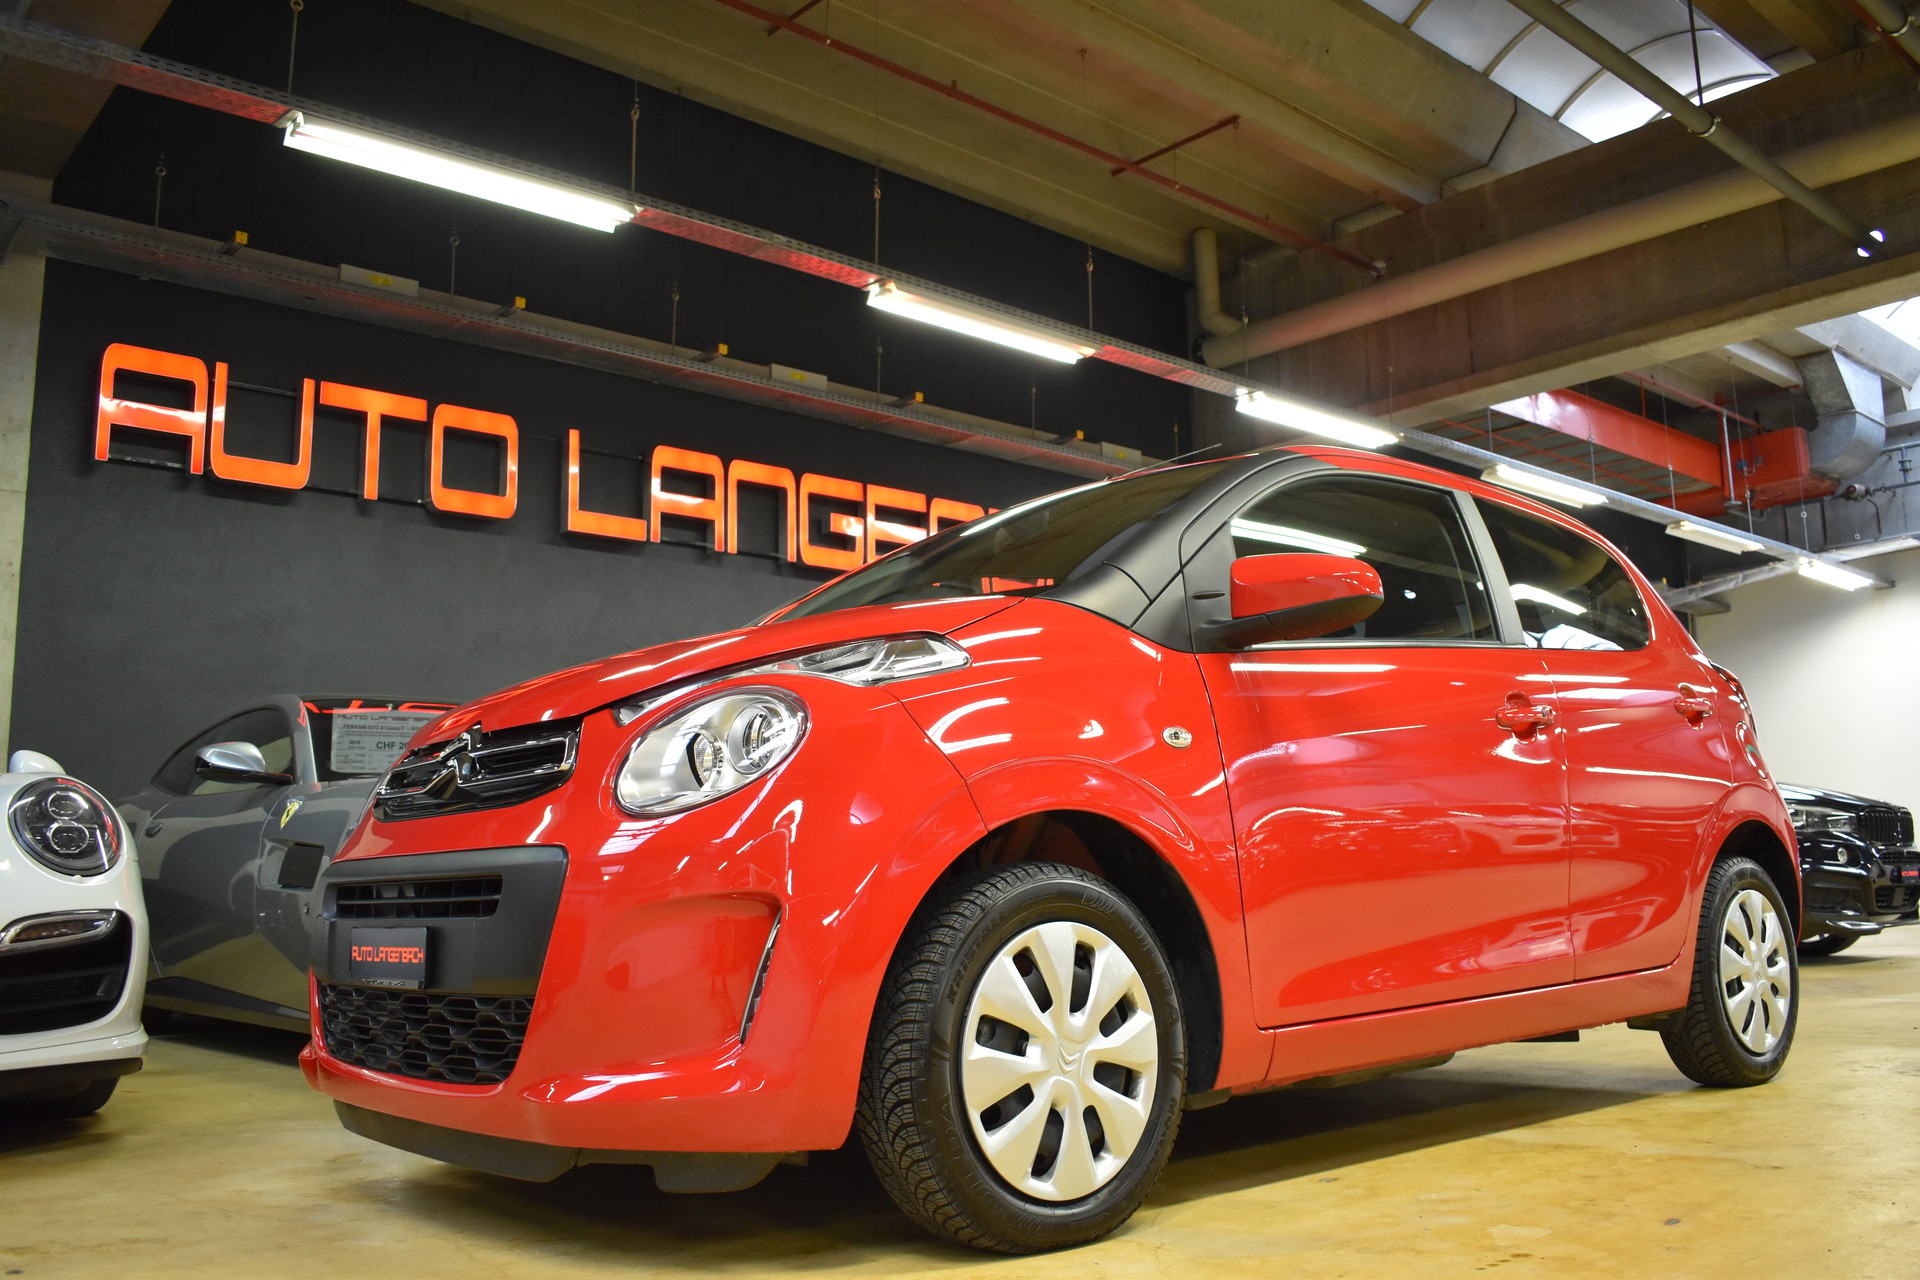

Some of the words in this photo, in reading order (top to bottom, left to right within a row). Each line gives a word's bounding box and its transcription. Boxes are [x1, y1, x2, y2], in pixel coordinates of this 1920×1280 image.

[94, 342, 519, 519] AUTO
[566, 428, 1001, 571] LANGE
[376, 741, 396, 750] CHF
[352, 946, 373, 962] AUTO
[374, 946, 424, 963] LANGENBACH
